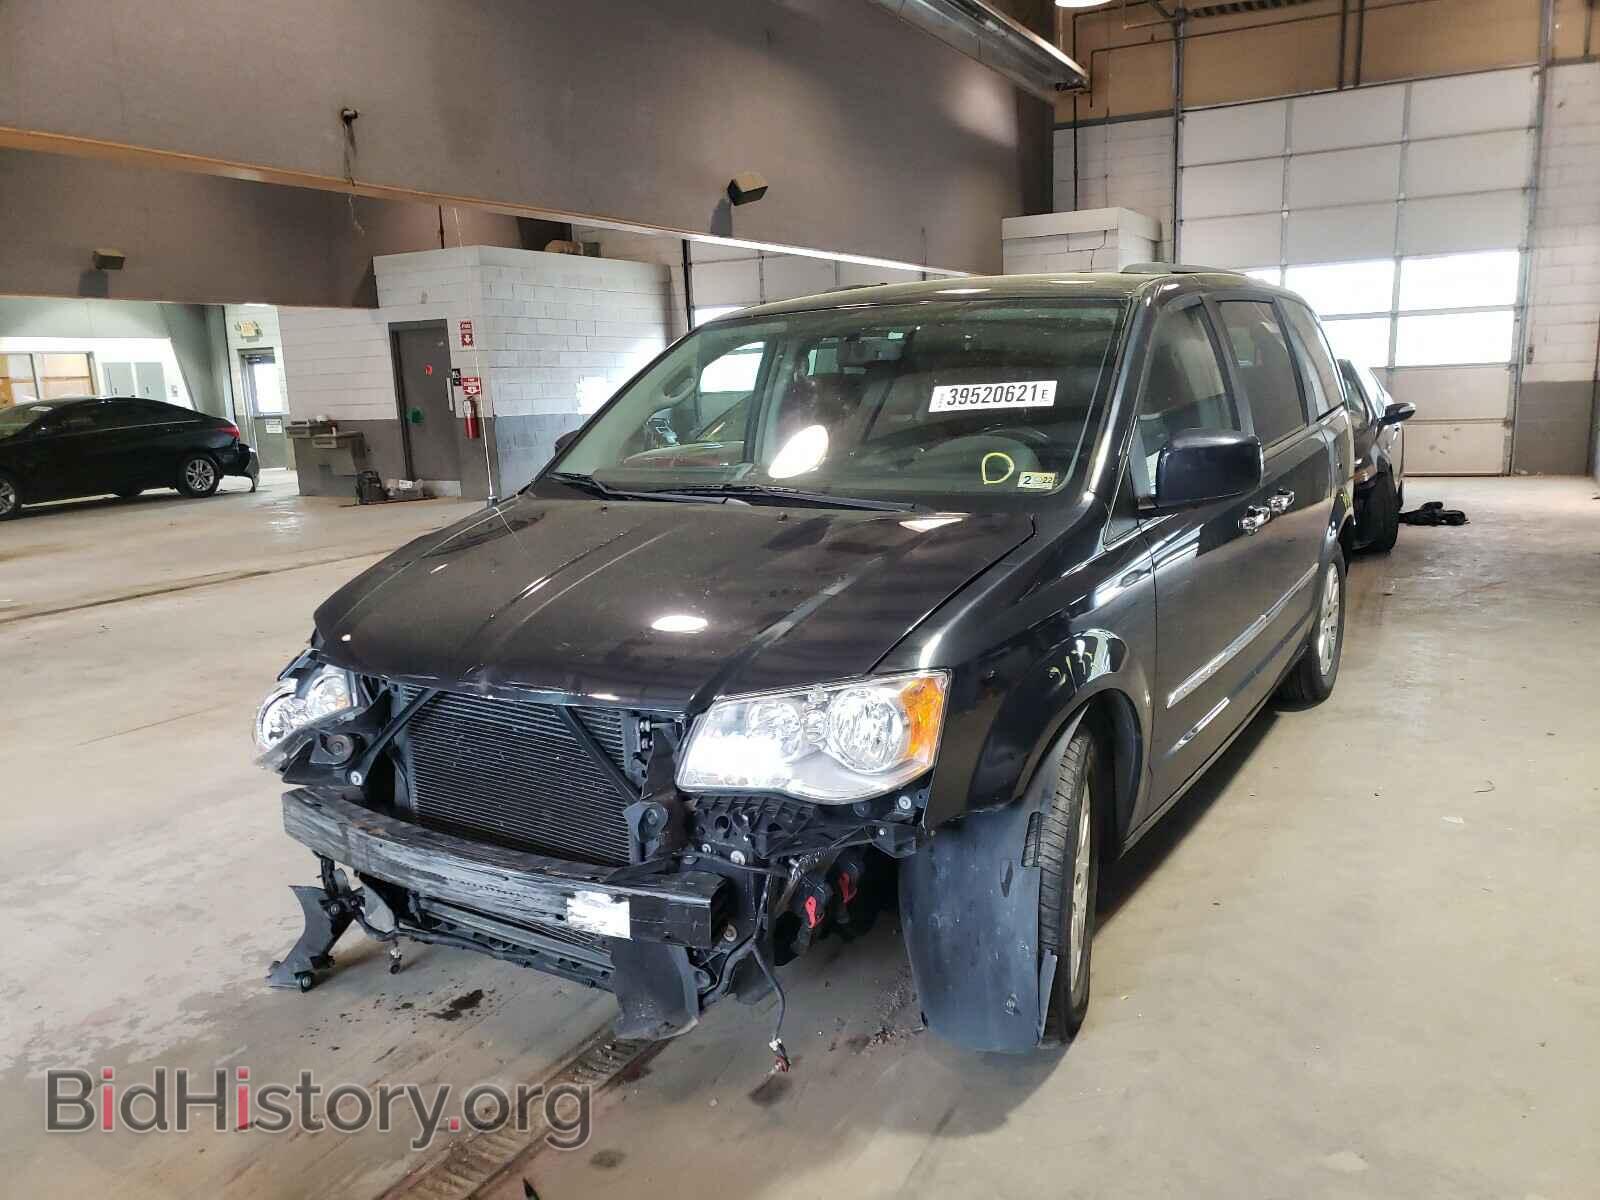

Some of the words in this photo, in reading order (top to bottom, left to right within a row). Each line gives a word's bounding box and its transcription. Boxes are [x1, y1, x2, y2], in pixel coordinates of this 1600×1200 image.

[947, 384, 1038, 406] 39520621
[1041, 389, 1049, 399] E
[1023, 475, 1032, 485] 2
